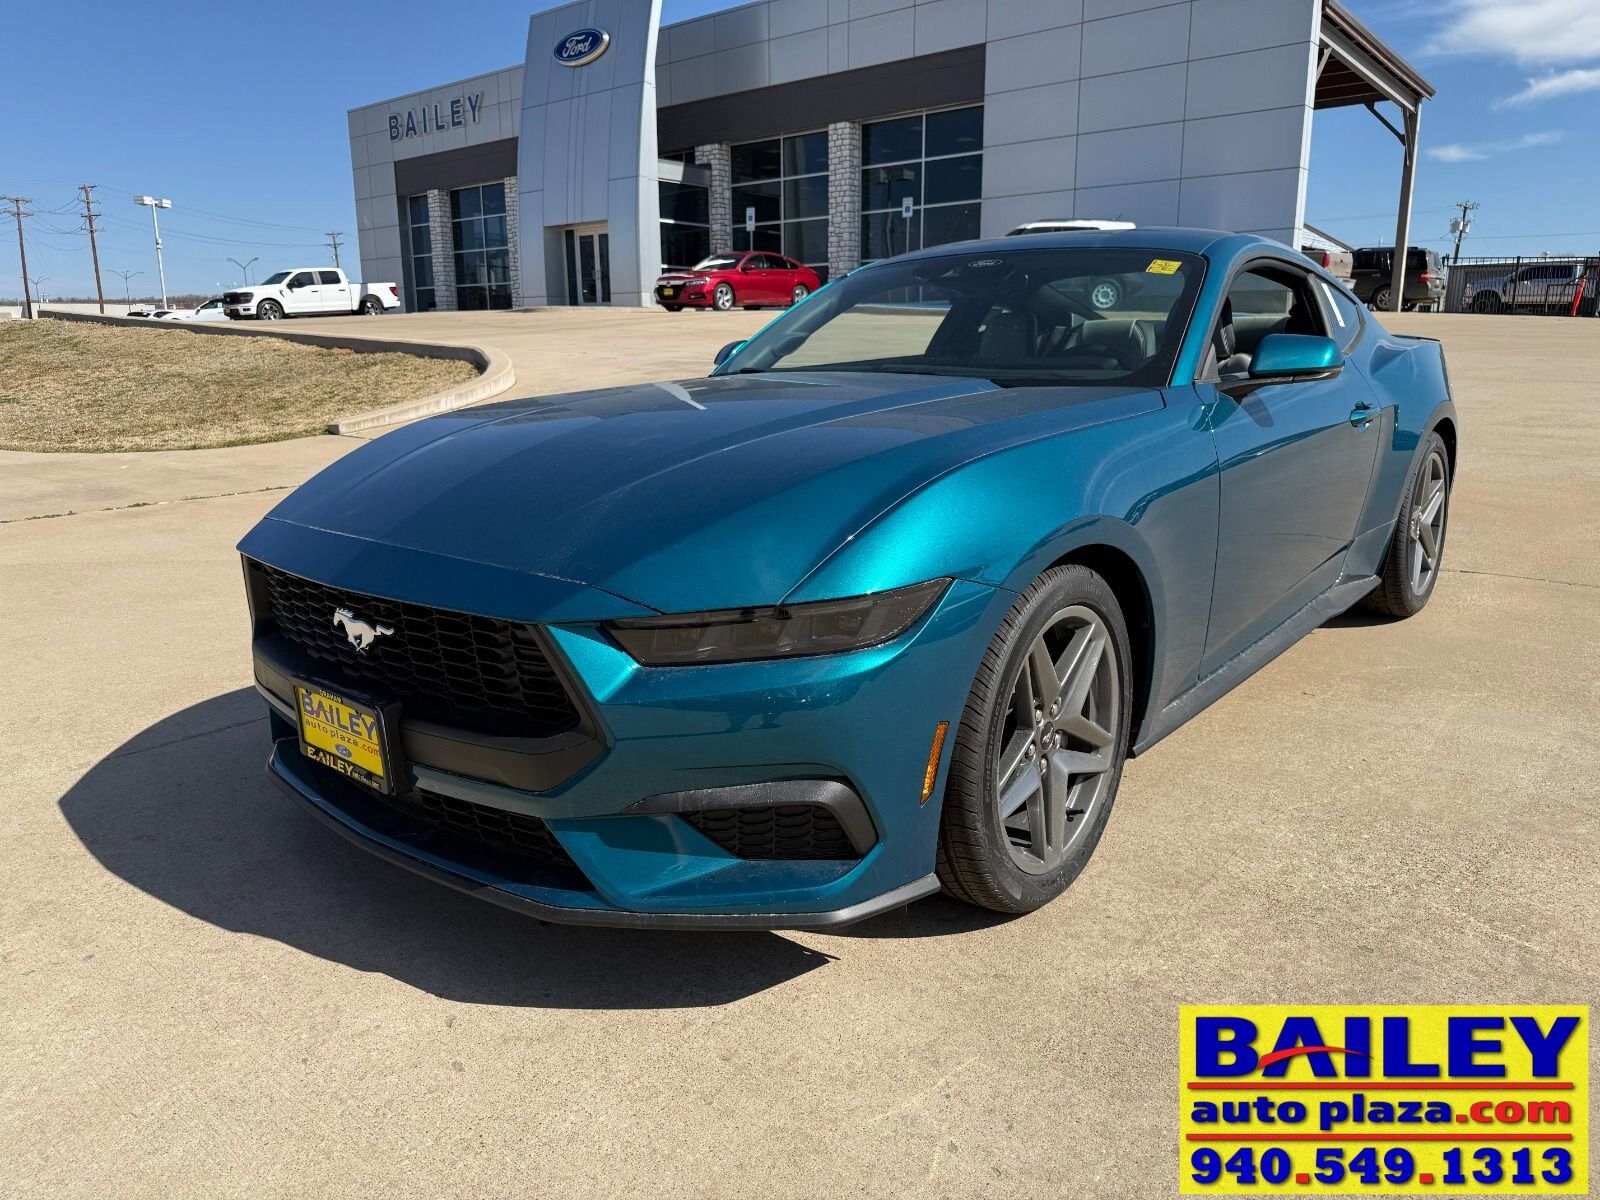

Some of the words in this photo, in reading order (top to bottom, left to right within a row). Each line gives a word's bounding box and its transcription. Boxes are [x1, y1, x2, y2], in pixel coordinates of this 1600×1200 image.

[562, 34, 593, 58] Ford
[388, 93, 481, 141] BAILEY
[301, 691, 377, 741] BAILEY
[305, 718, 328, 734] auto
